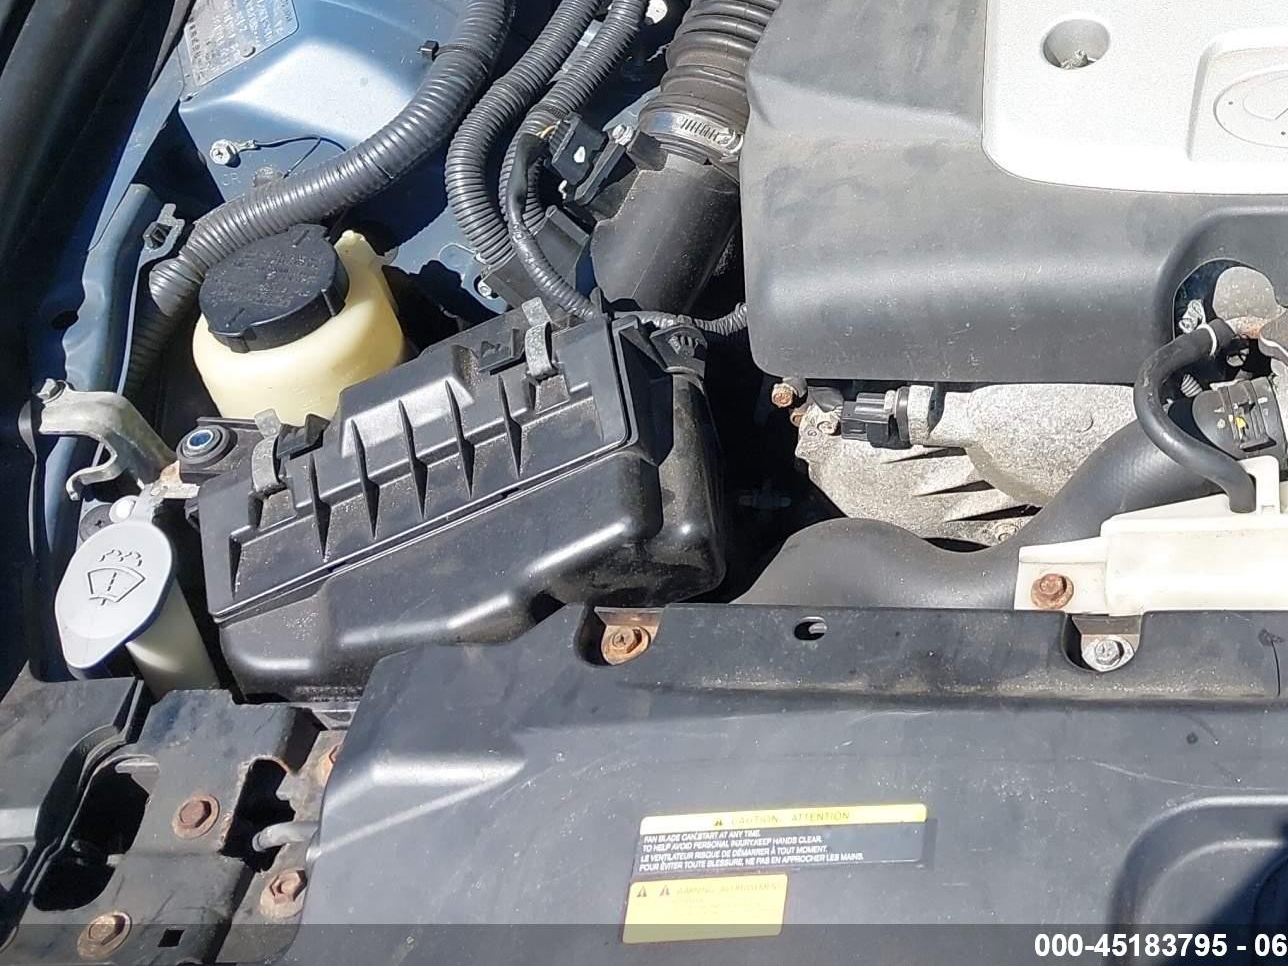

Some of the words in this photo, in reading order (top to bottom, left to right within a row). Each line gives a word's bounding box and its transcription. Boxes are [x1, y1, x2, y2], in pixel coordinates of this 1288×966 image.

[718, 831, 727, 839] AT
[729, 830, 743, 838] ANY
[671, 842, 692, 850] AVOID
[693, 840, 730, 849] PERSONAL
[772, 836, 797, 844] HANDS
[640, 854, 650, 862] LE
[721, 850, 731, 858] DE
[777, 846, 795, 855] TOUT
[639, 862, 659, 872] POUR
[684, 860, 706, 869] TOUTE
[745, 858, 756, 866] NE
[756, 857, 770, 865] PAS
[771, 856, 782, 864] EN
[826, 854, 840, 862] LES
